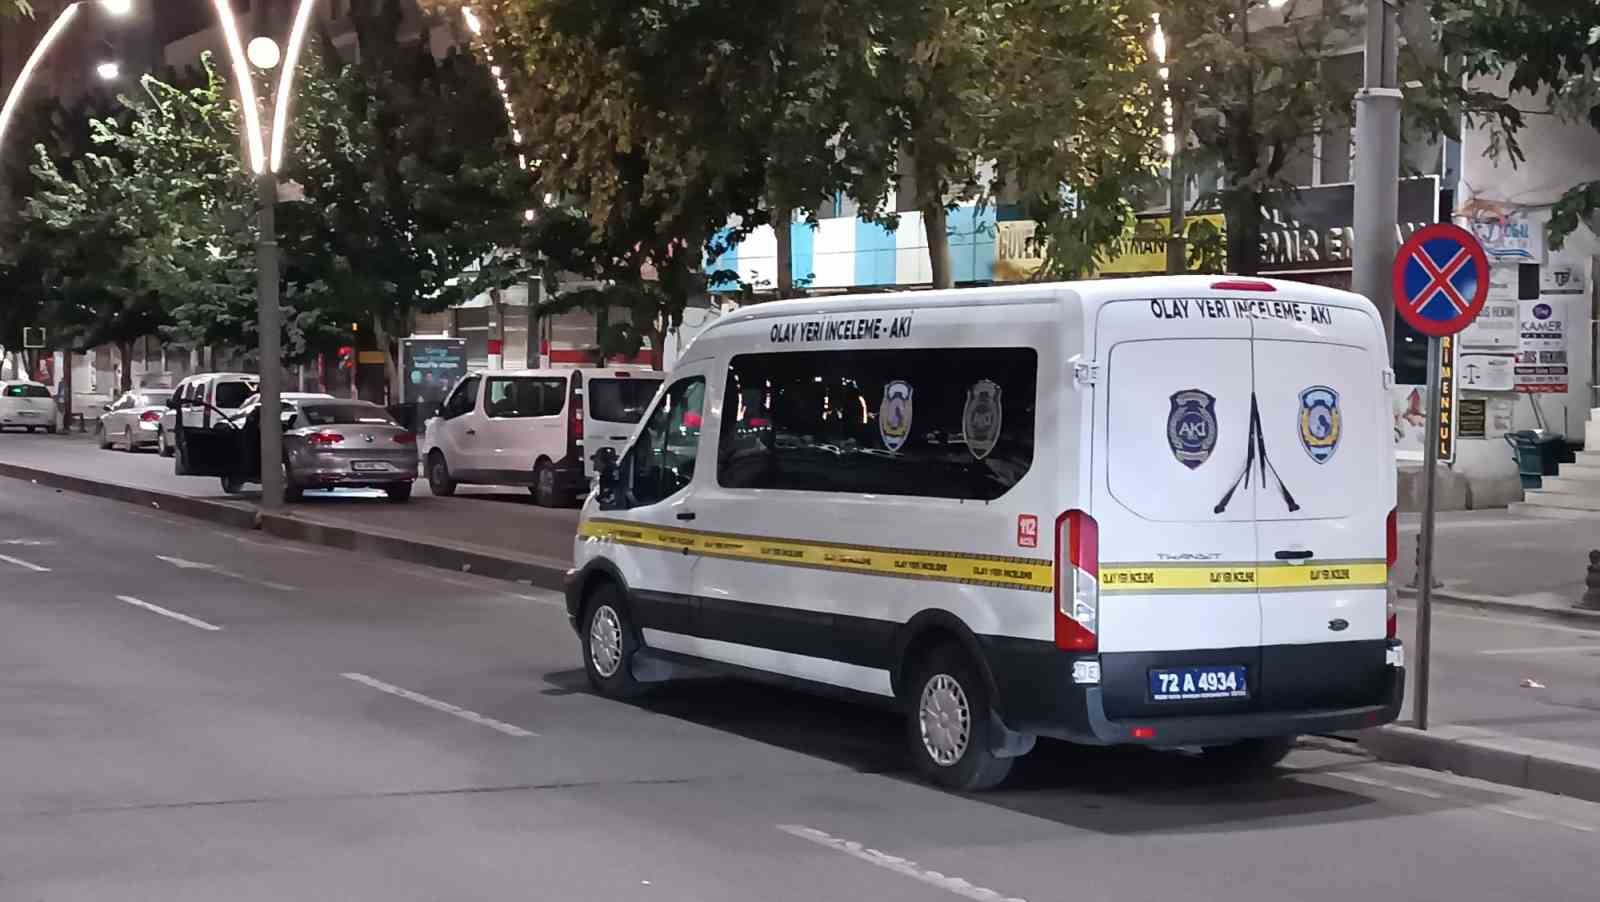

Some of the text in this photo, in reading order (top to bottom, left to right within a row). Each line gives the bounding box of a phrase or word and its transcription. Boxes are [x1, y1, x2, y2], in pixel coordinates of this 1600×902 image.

[1151, 299, 1188, 319] OLAY
[770, 322, 798, 342] OLAY
[1520, 321, 1563, 332] KAMER
[1159, 671, 1237, 693] 72 A 4934
